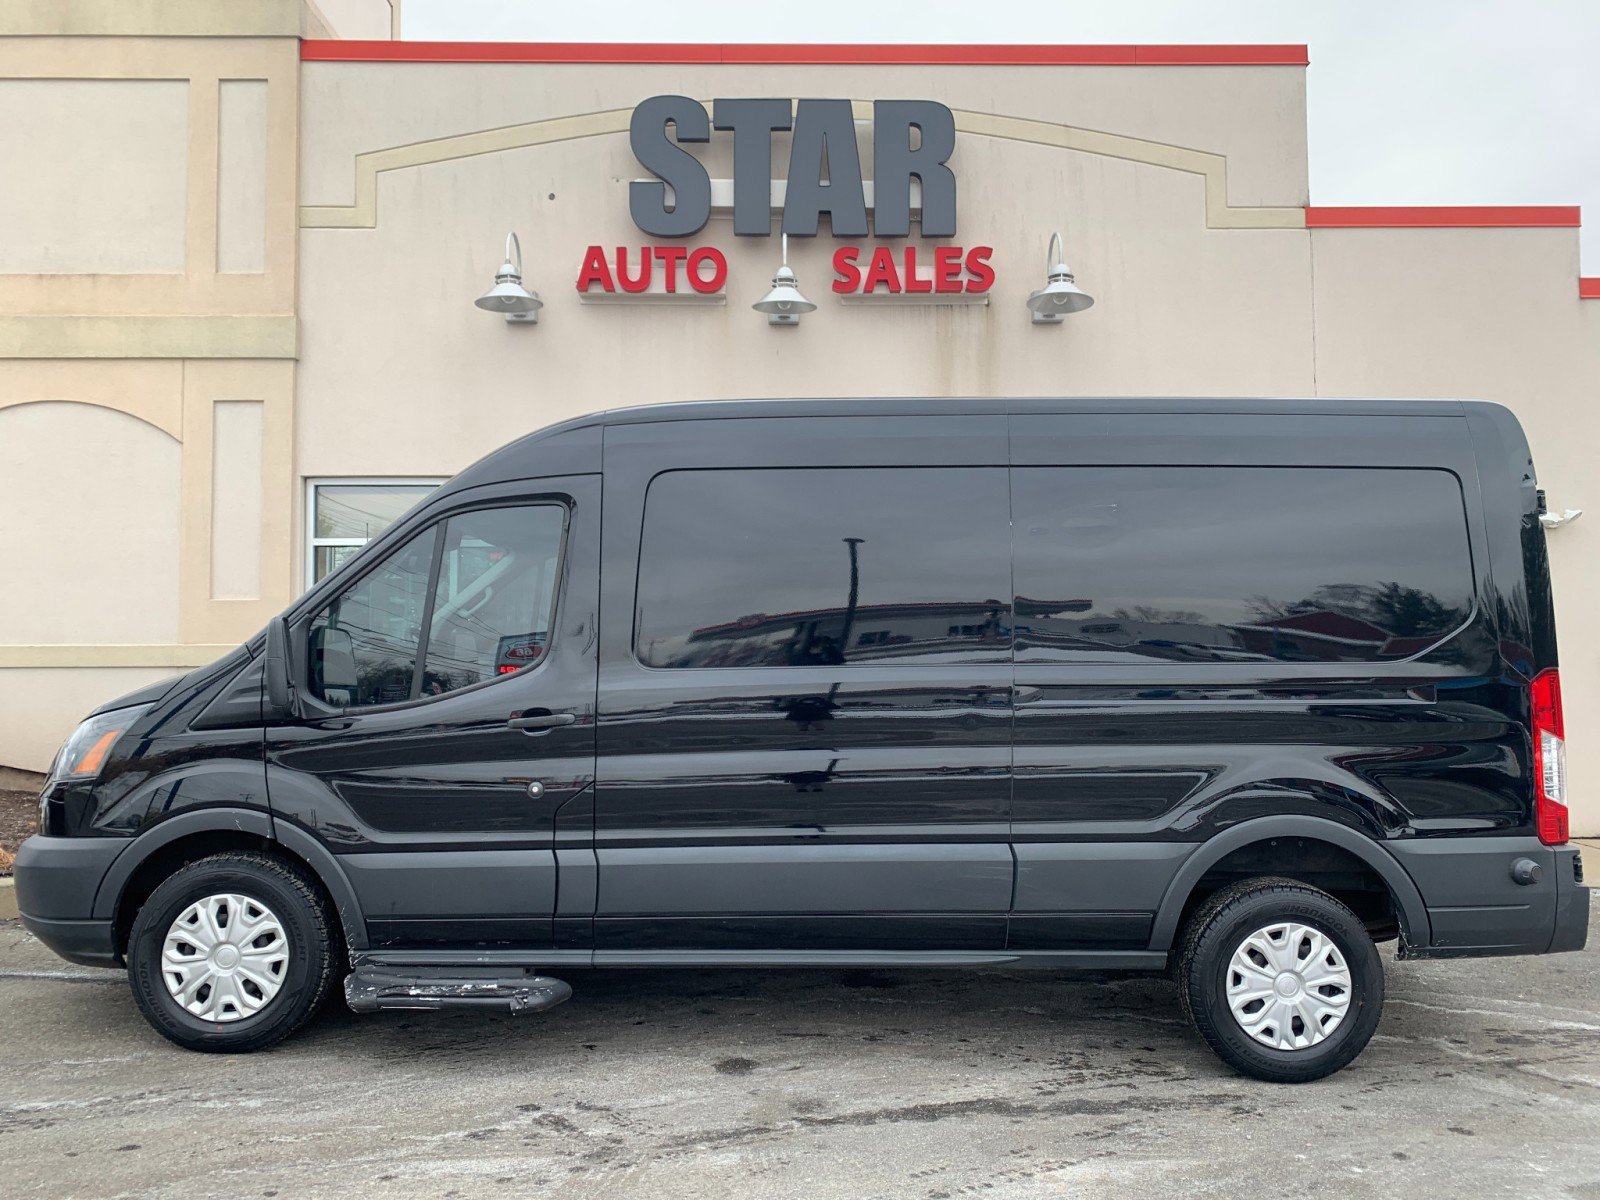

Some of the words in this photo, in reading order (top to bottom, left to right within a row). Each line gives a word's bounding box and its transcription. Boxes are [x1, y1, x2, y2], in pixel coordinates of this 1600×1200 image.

[629, 95, 956, 238] STAR
[576, 246, 728, 293] AUTO
[832, 246, 995, 294] SALES
